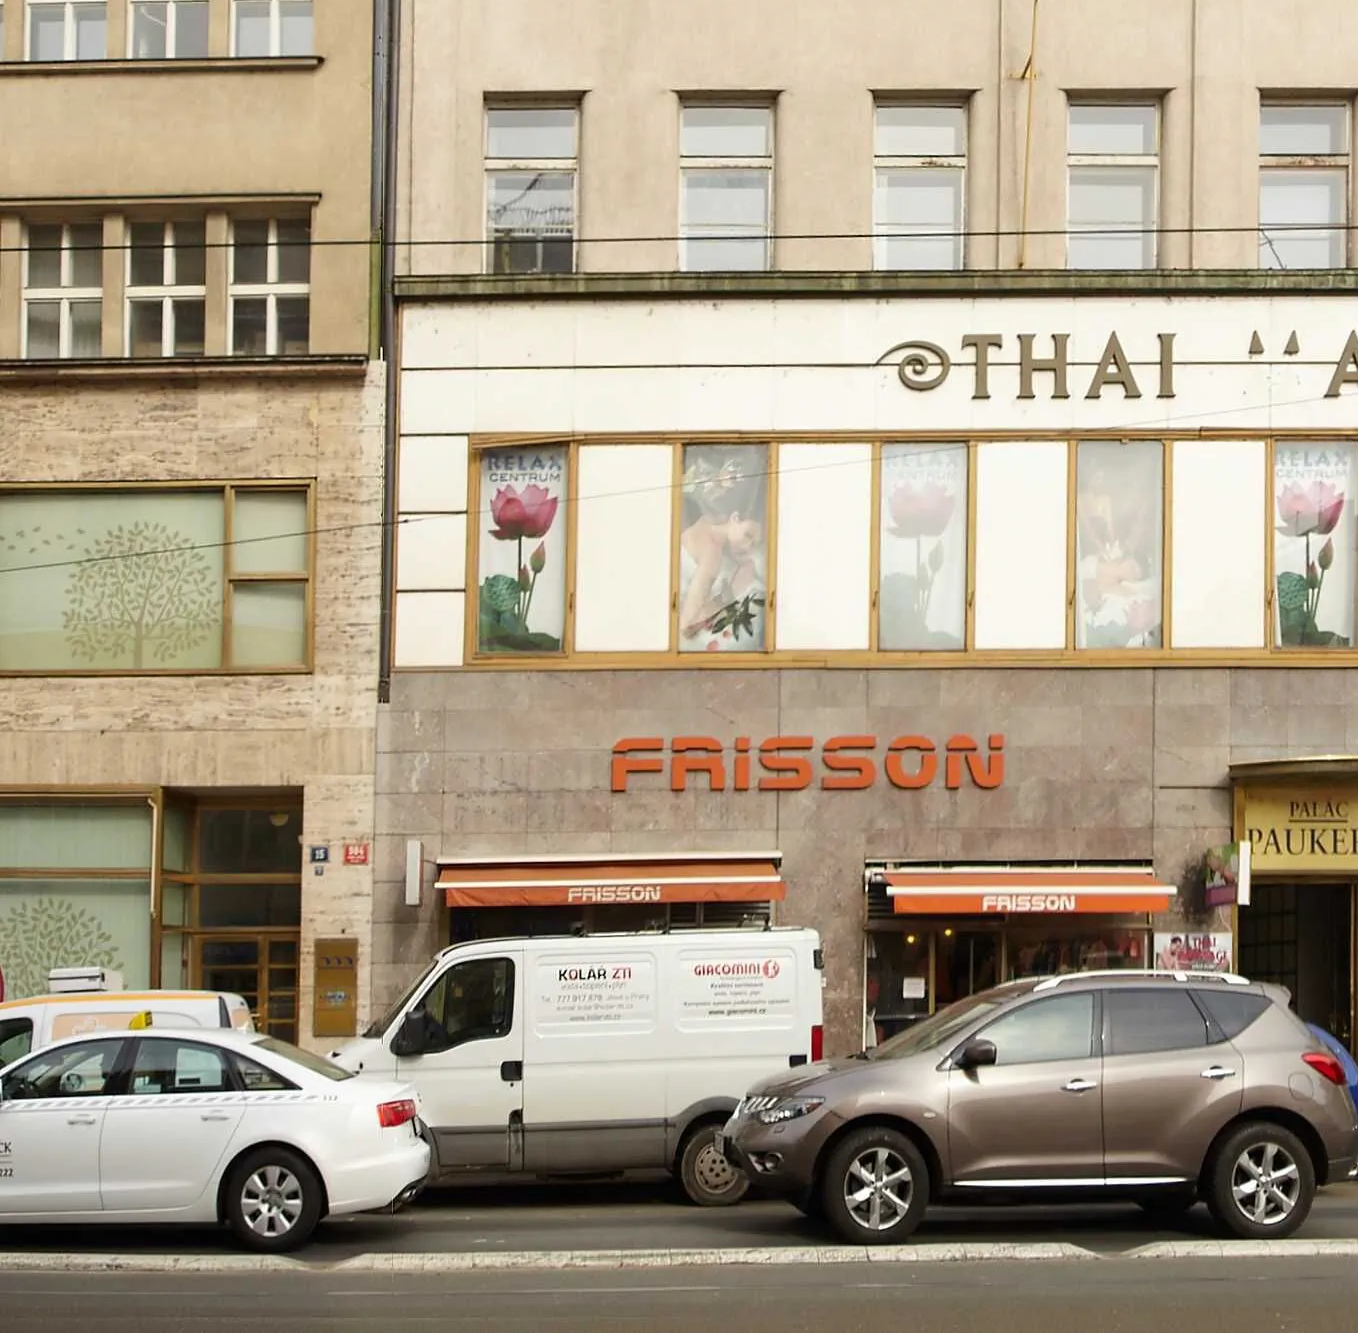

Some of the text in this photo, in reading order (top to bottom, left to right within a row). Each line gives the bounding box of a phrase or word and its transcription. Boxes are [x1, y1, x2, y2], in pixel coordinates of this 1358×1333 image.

[961, 330, 1176, 400] THAI
[487, 453, 562, 470] RELAX
[489, 473, 561, 482] CENTRUM
[611, 734, 1005, 792] FRISSON
[567, 885, 661, 903] FRISSON
[982, 895, 1076, 912] FRISSON
[694, 962, 760, 976] GIACOMINI
